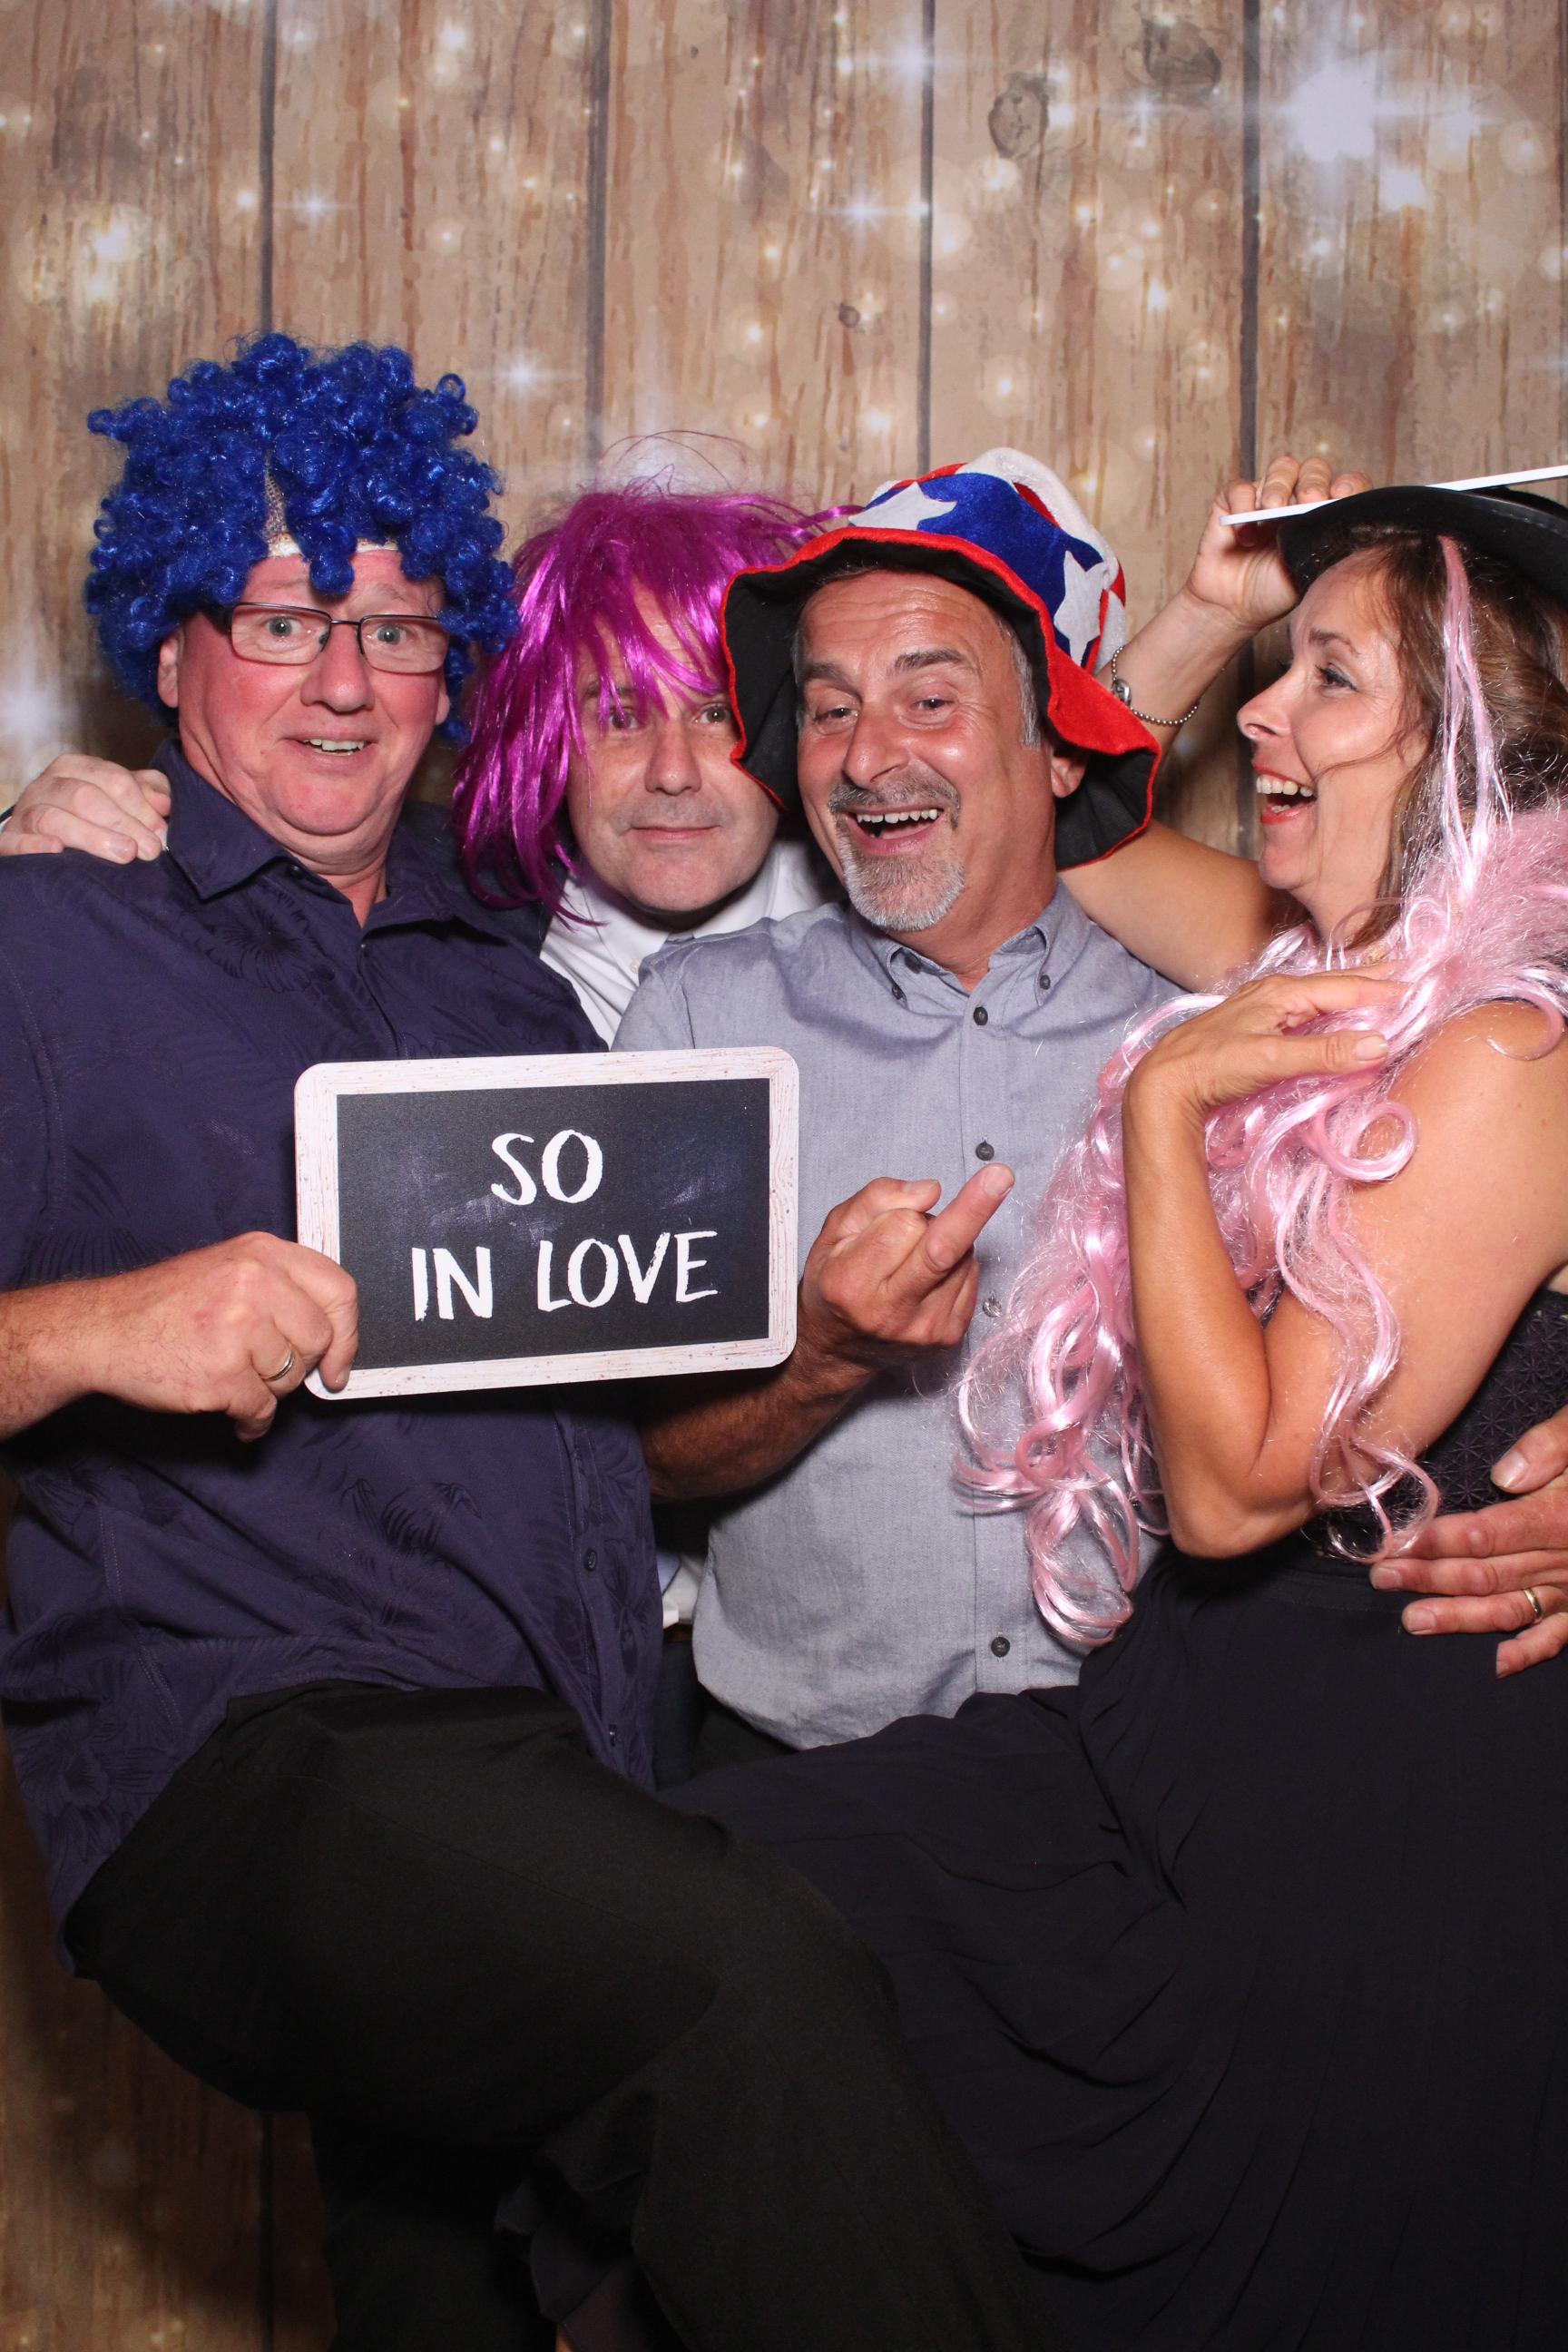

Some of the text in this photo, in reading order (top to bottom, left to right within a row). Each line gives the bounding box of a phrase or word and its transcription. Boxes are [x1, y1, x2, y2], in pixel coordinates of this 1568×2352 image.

[490, 1129, 603, 1206] SO
[411, 1230, 719, 1322] IN LOVE
